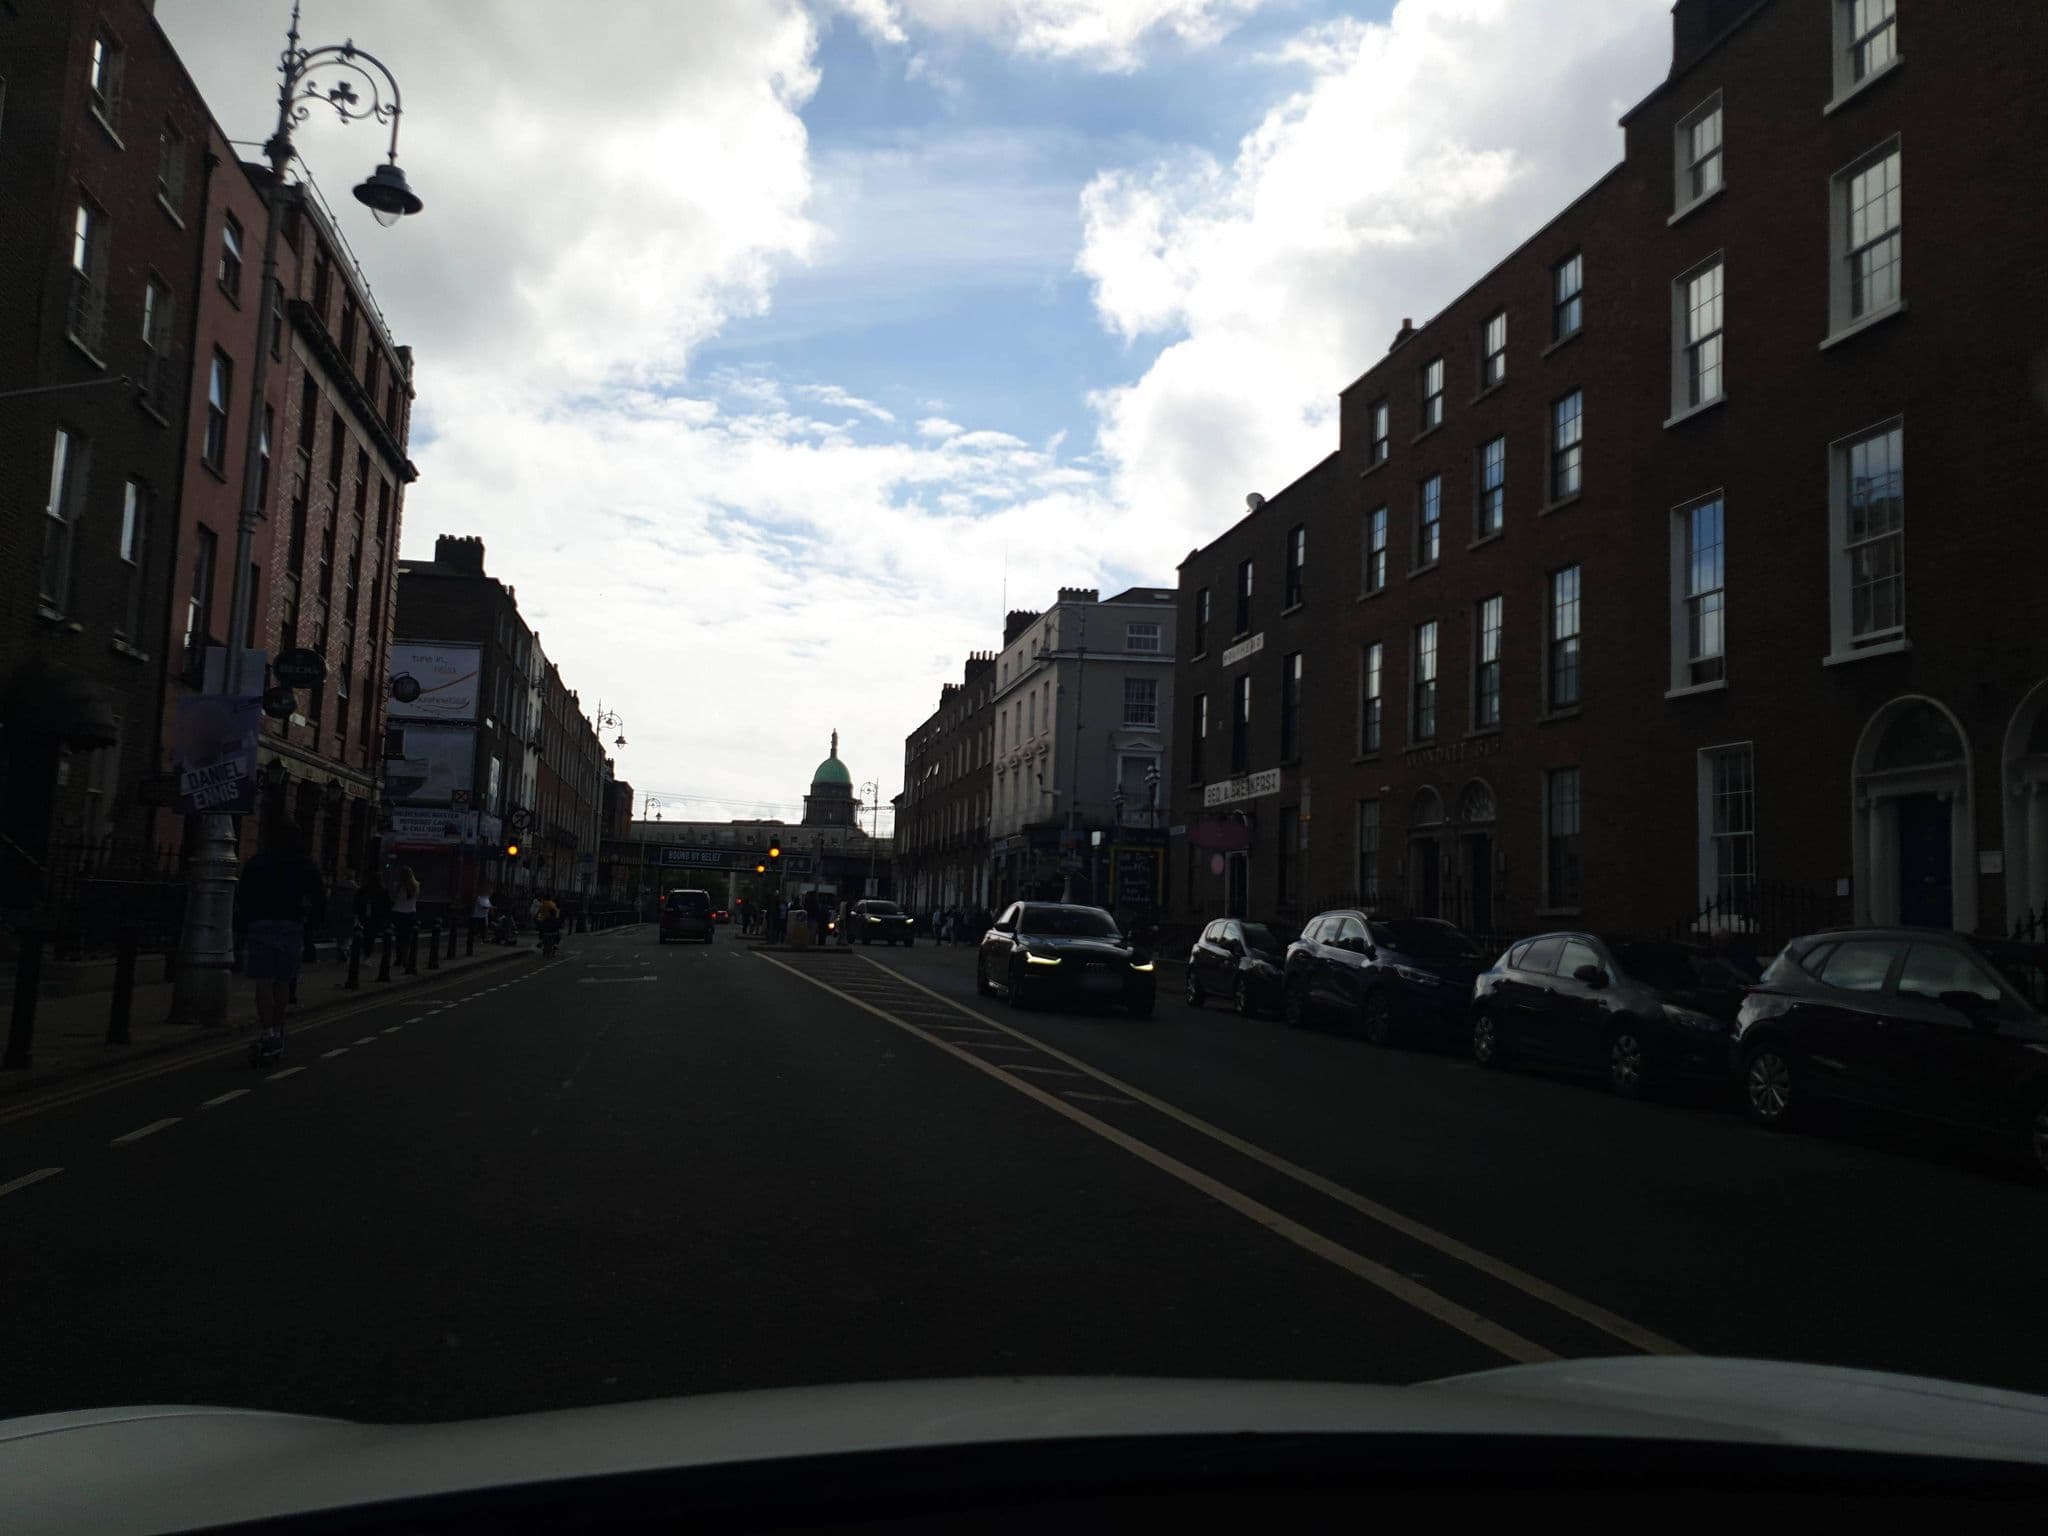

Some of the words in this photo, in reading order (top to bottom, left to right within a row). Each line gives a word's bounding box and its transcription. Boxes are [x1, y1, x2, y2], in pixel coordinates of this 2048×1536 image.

[186, 761, 242, 790] DANIEL
[1231, 772, 1277, 799] BREAKFAST
[193, 782, 240, 810] ENNIS
